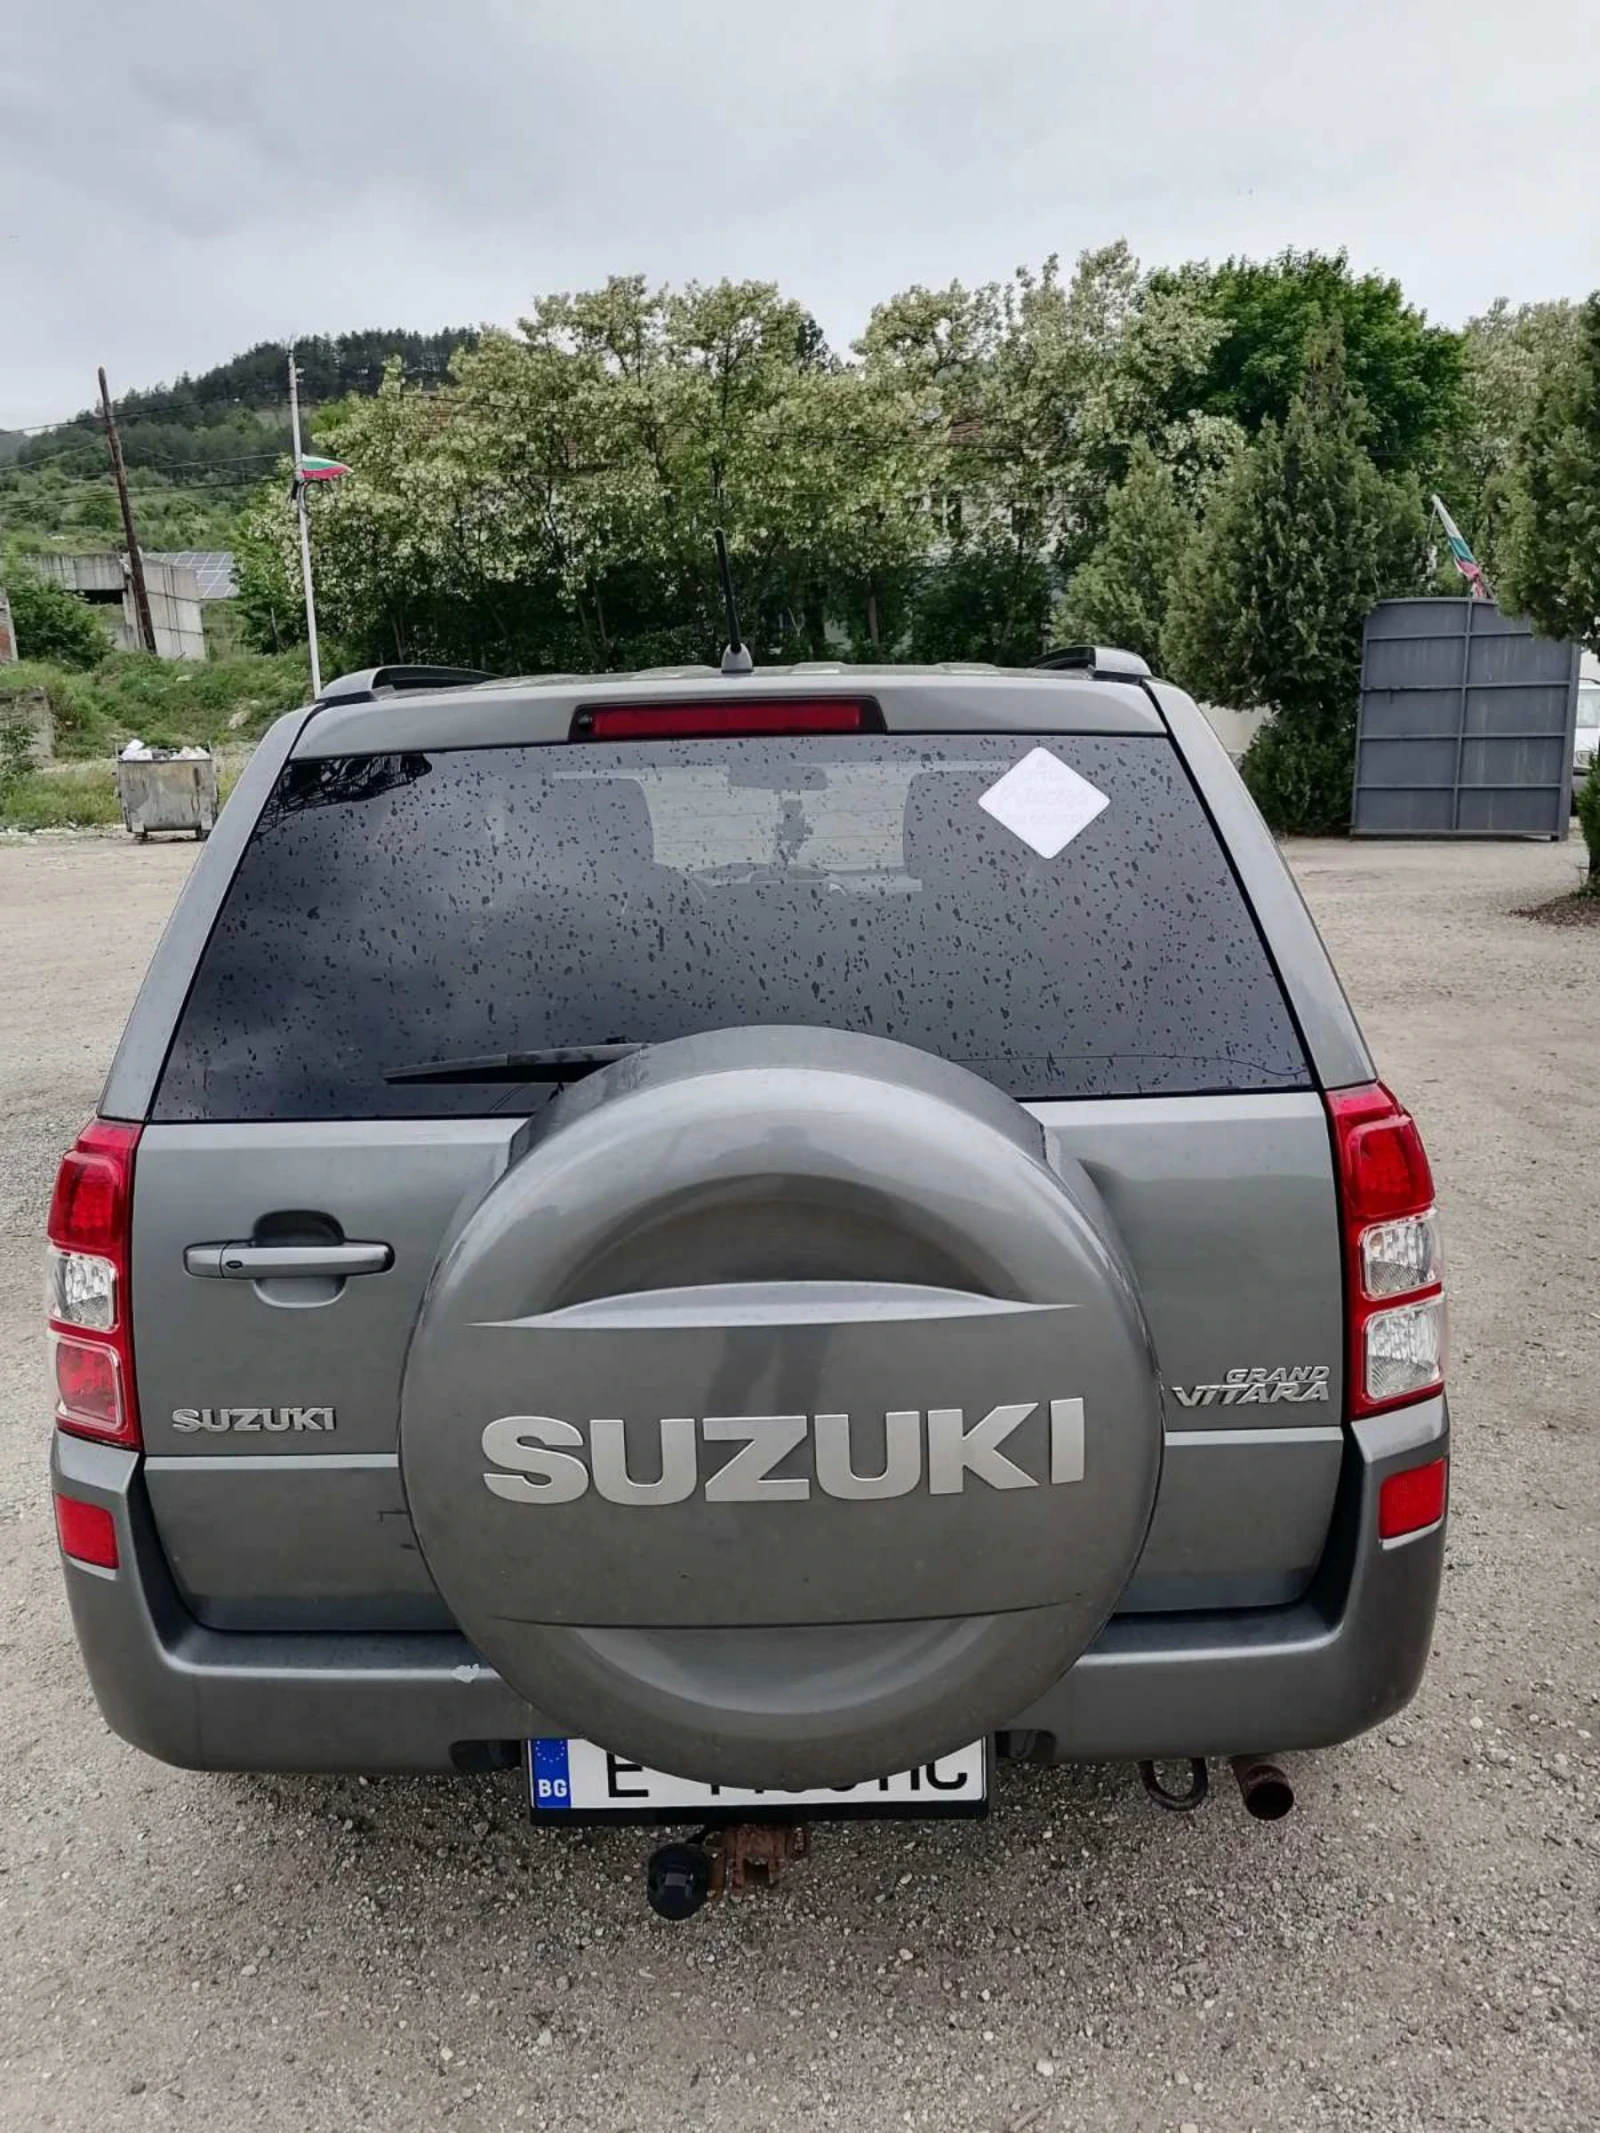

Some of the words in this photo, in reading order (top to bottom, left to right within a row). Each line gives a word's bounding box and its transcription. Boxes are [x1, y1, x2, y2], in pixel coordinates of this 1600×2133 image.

[1226, 1366, 1330, 1384] GRAND
[1172, 1381, 1329, 1407] VITARA
[172, 1407, 336, 1432] SUZUKI
[481, 1397, 1085, 1505] SUZUKI
[538, 1779, 568, 1798] BG
